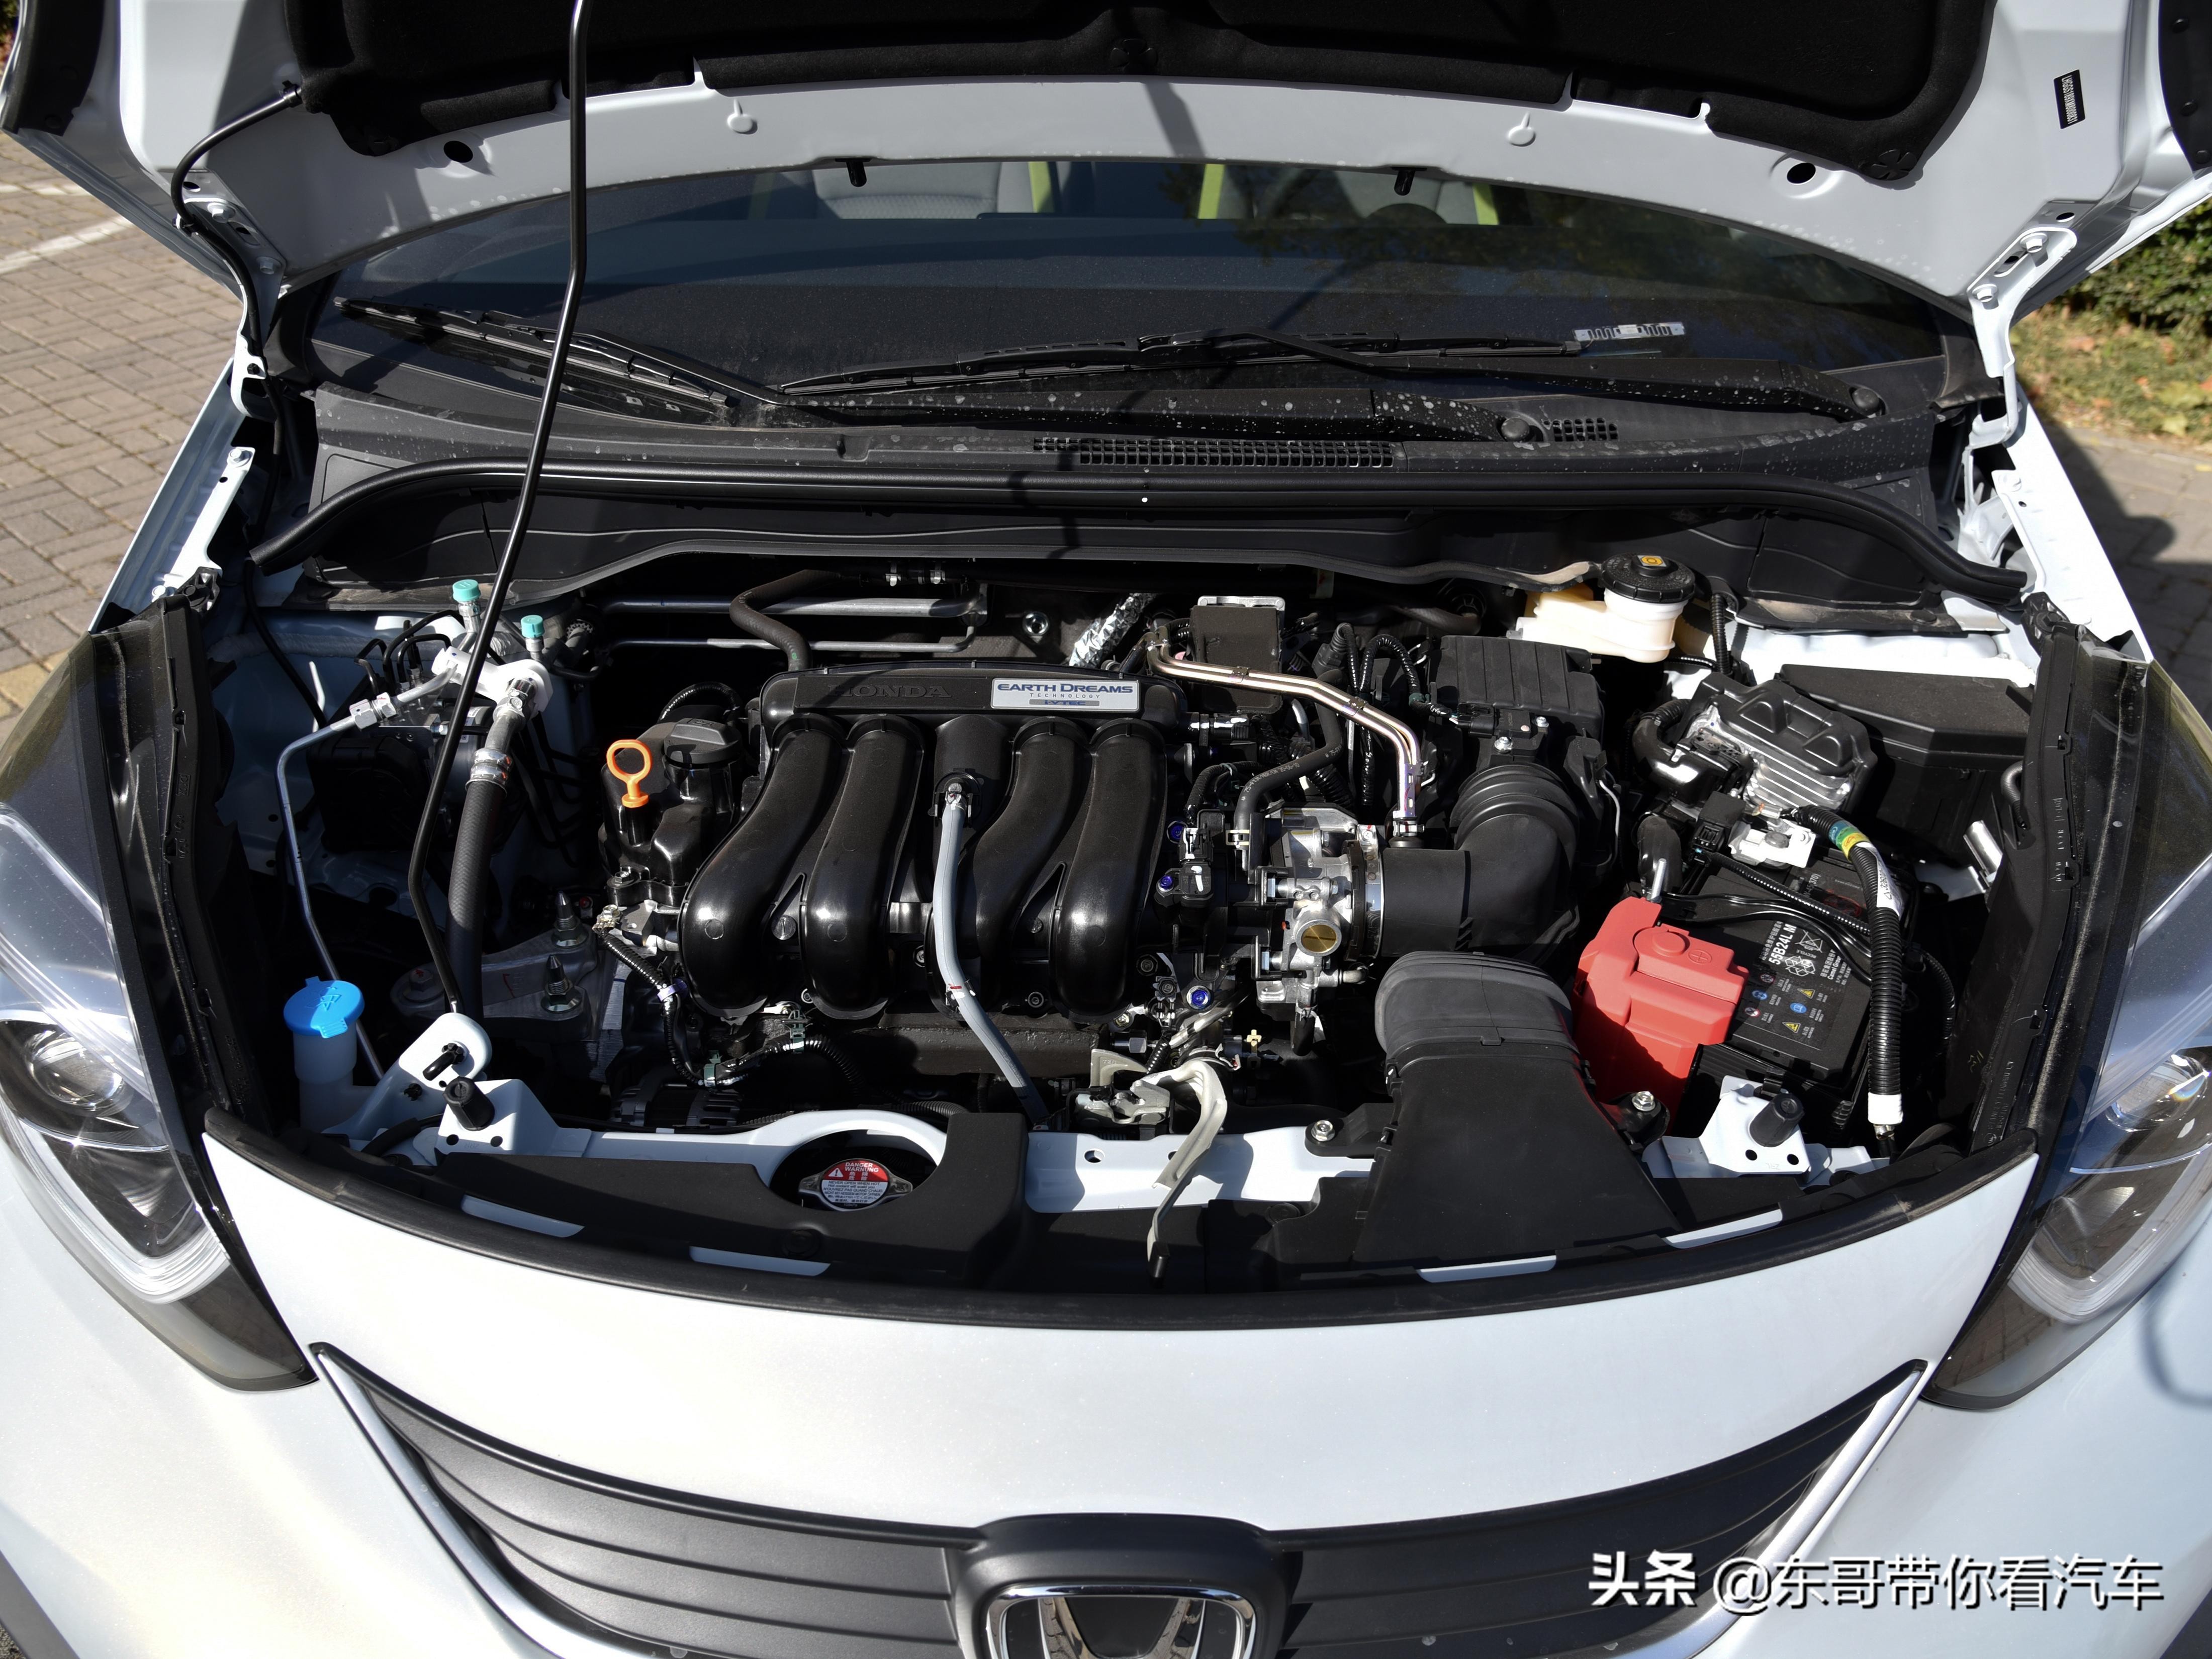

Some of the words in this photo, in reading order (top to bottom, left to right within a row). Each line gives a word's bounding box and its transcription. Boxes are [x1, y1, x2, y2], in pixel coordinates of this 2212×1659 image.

[827, 684, 953, 698] HONDA
[997, 683, 1056, 692] EARTH
[1060, 683, 1133, 693] DREAMS
[1768, 934, 1793, 965] 55B24L
[1795, 949, 1816, 959] RECYCLE
